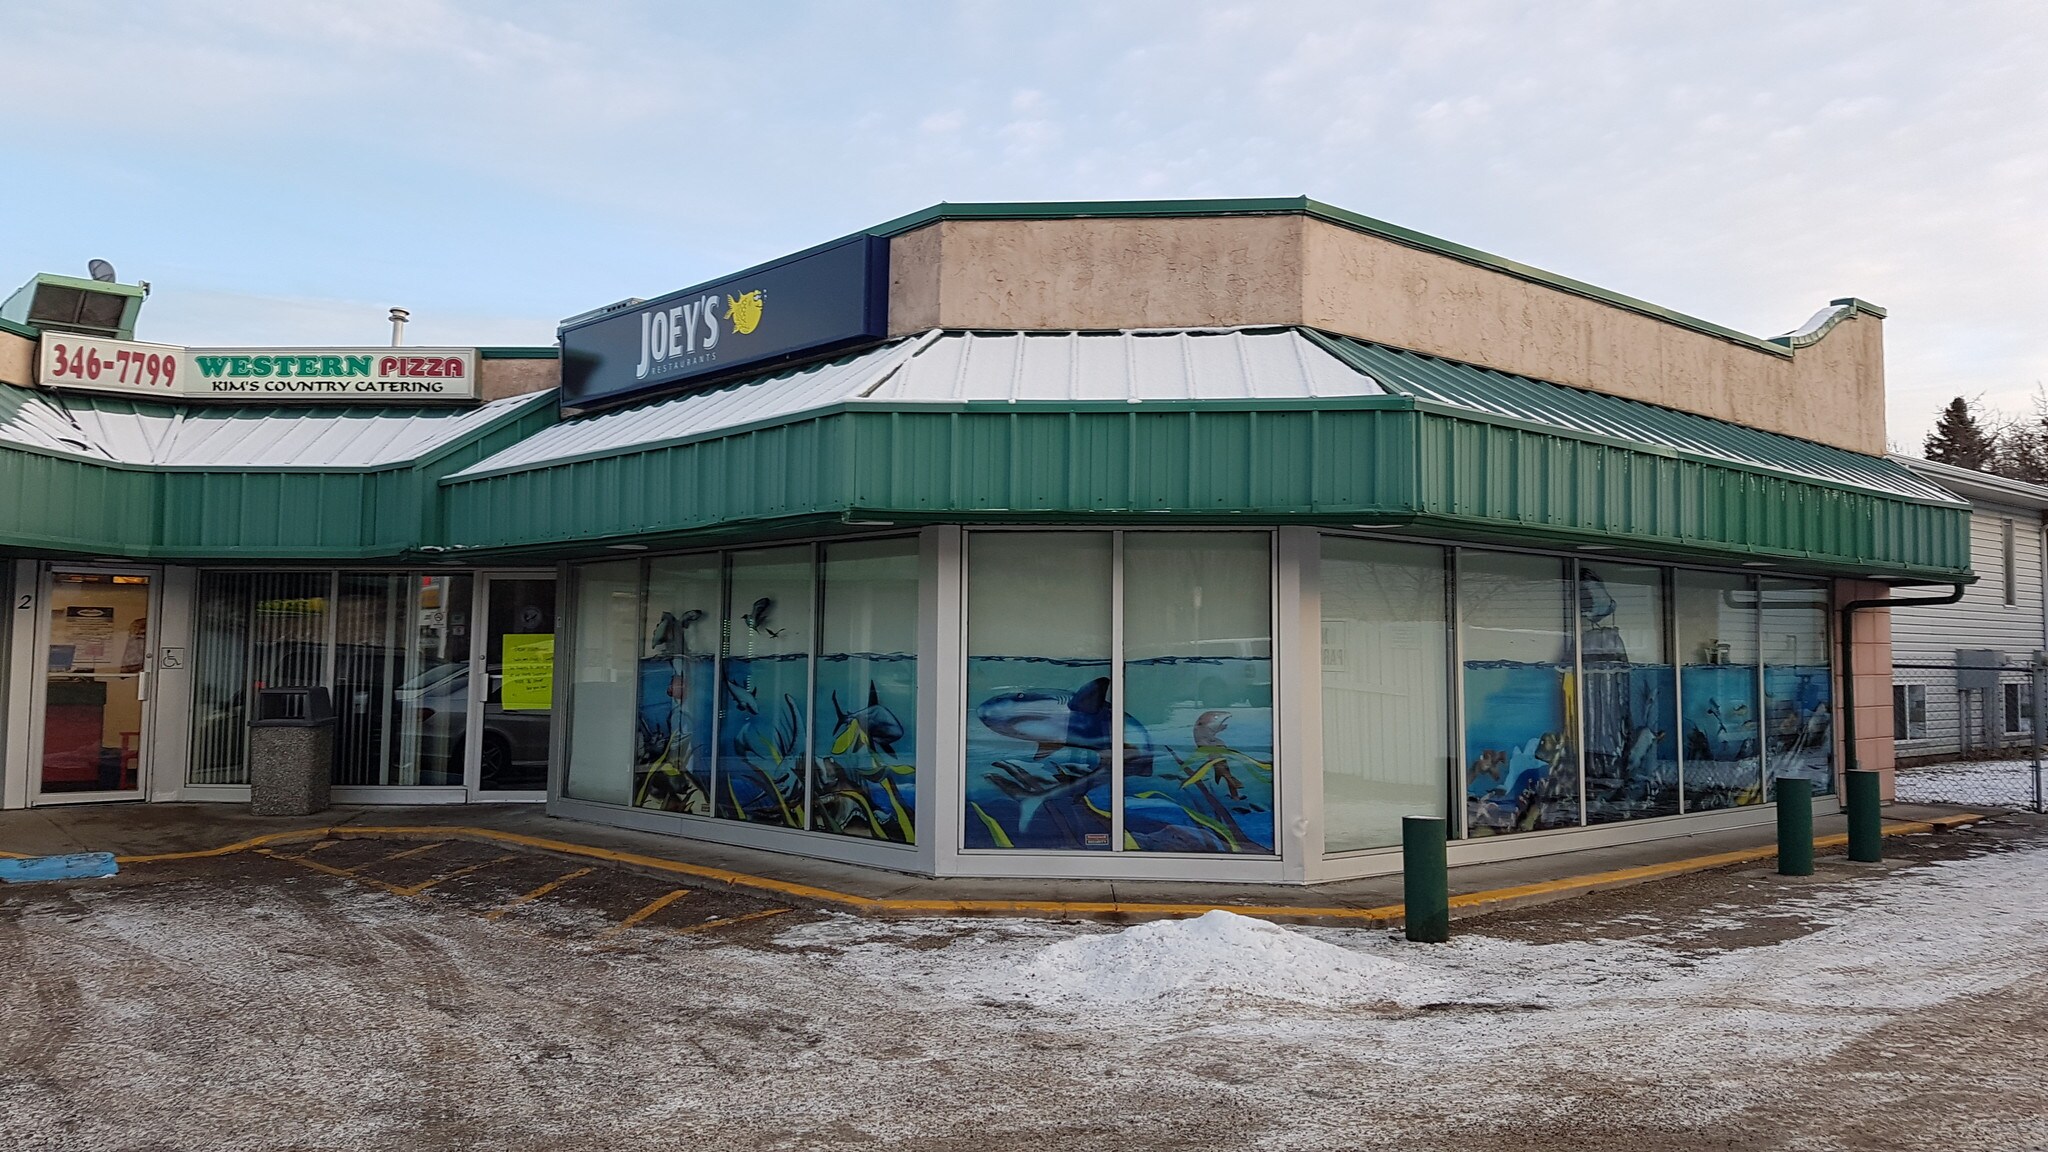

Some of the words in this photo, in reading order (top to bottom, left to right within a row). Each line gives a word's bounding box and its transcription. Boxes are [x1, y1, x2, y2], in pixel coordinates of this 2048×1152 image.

[636, 295, 720, 380] JOEY'S
[52, 343, 176, 388] 346-7799
[195, 355, 374, 378] WESTERN
[378, 356, 464, 378] PIZZA
[652, 352, 717, 375] RESTAURANTS
[212, 381, 260, 391] KIM'S
[264, 381, 351, 392] COUNTRY
[355, 381, 443, 393] CATERING
[17, 594, 32, 610] 2
